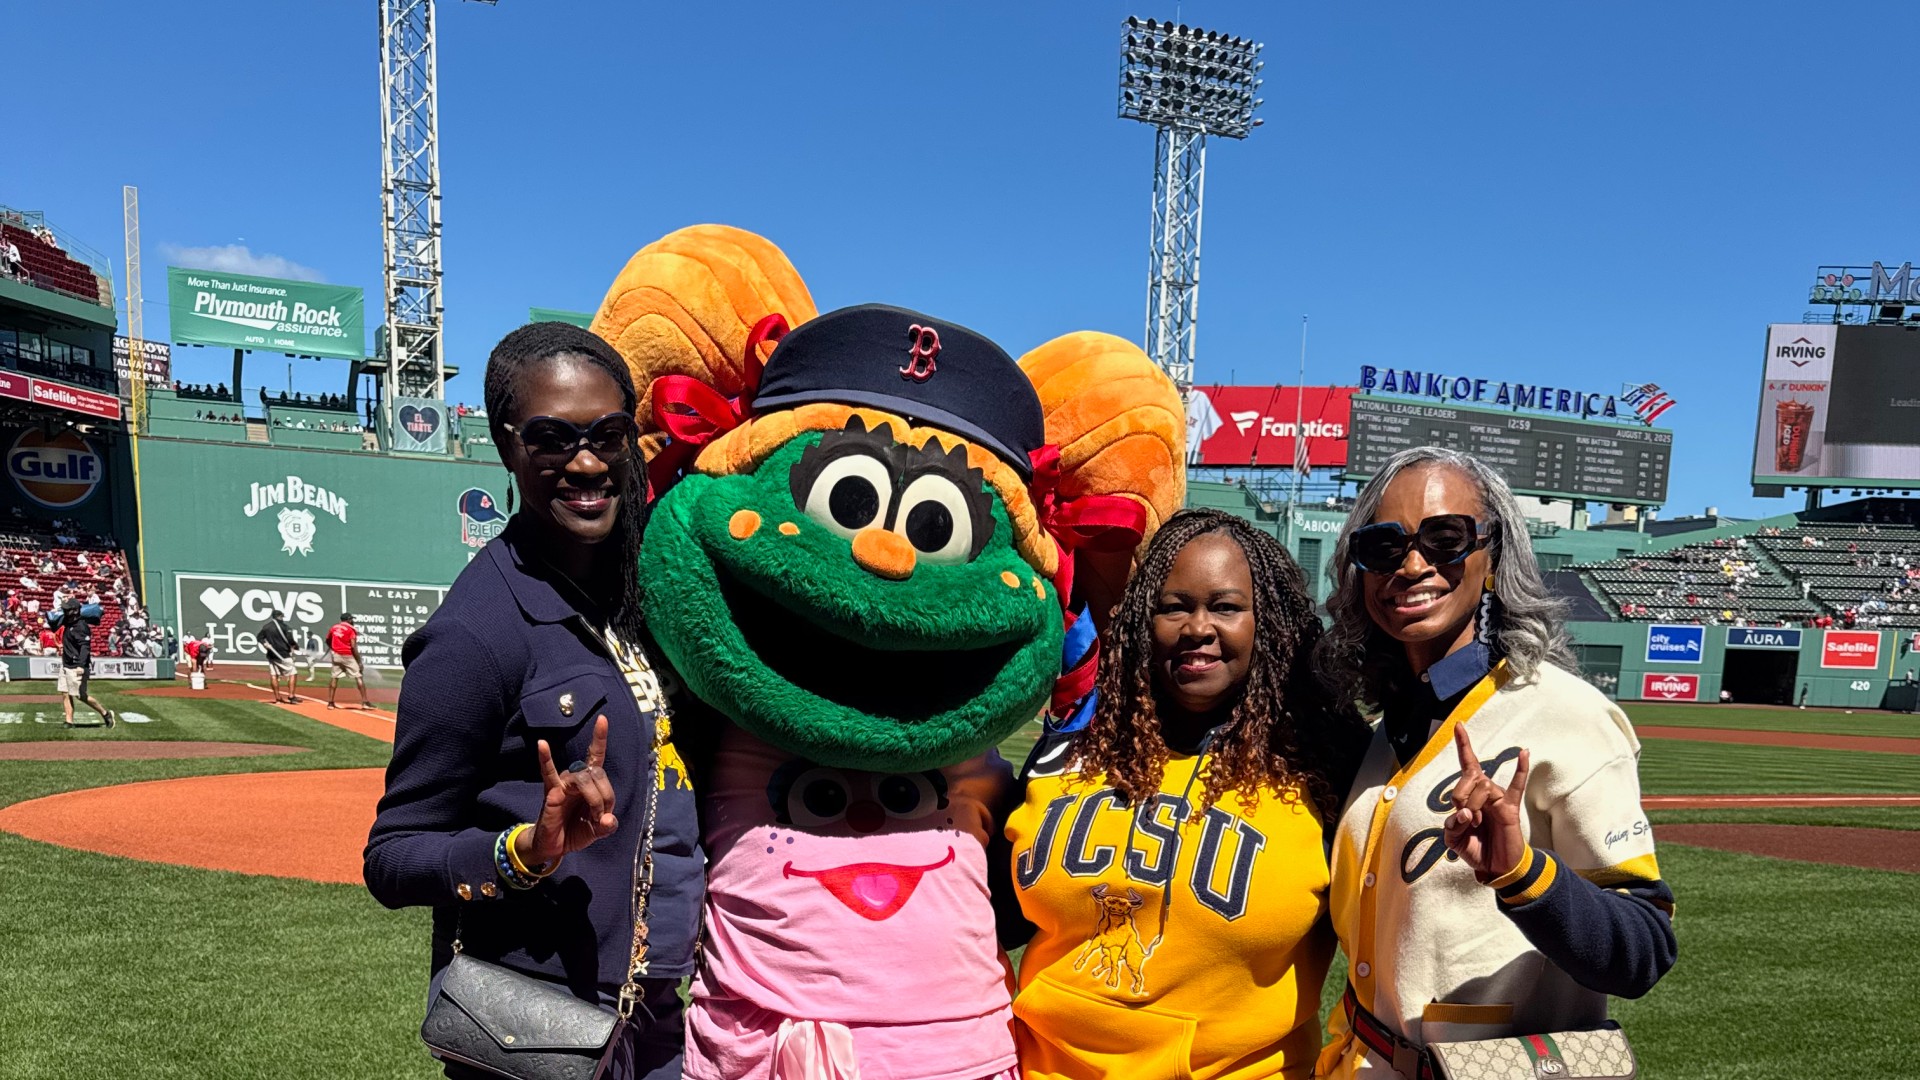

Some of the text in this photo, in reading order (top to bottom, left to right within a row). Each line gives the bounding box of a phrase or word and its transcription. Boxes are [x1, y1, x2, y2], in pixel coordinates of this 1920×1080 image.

[187, 277, 288, 296] More Than Just Insurance.
[194, 291, 342, 327] Plymouth Rock
[244, 335, 295, 347] AUTO HOME
[900, 324, 942, 383] B
[1776, 346, 1826, 358] IRVING
[34, 385, 77, 406] Safelite
[1360, 364, 1619, 418] BANK OF AMERICA
[1353, 400, 1457, 419] NATIONAL LEAGUE LEADERS
[414, 413, 425, 423] EL
[1356, 413, 1410, 426] BATTING AVERAGE
[1261, 416, 1343, 437] Fanatics
[1507, 419, 1531, 431] 12:59
[1616, 429, 1642, 439] AUGUST
[1654, 433, 1671, 443] 2025
[11, 451, 95, 480] Gulf
[243, 475, 348, 523] JIM BEAM
[468, 522, 505, 537] RED
[368, 590, 418, 600] AL EAST
[241, 589, 325, 624] CVS
[393, 605, 428, 614] W L GB
[366, 625, 388, 634] YORK
[1651, 634, 1670, 644] city
[374, 646, 389, 655] BAY
[1650, 644, 1685, 652] cruises
[1827, 643, 1876, 652] Safelite
[123, 662, 145, 672] TRULY
[1651, 682, 1691, 692] IRVING
[1850, 681, 1870, 690] 420
[1016, 787, 1267, 922] JCSU
